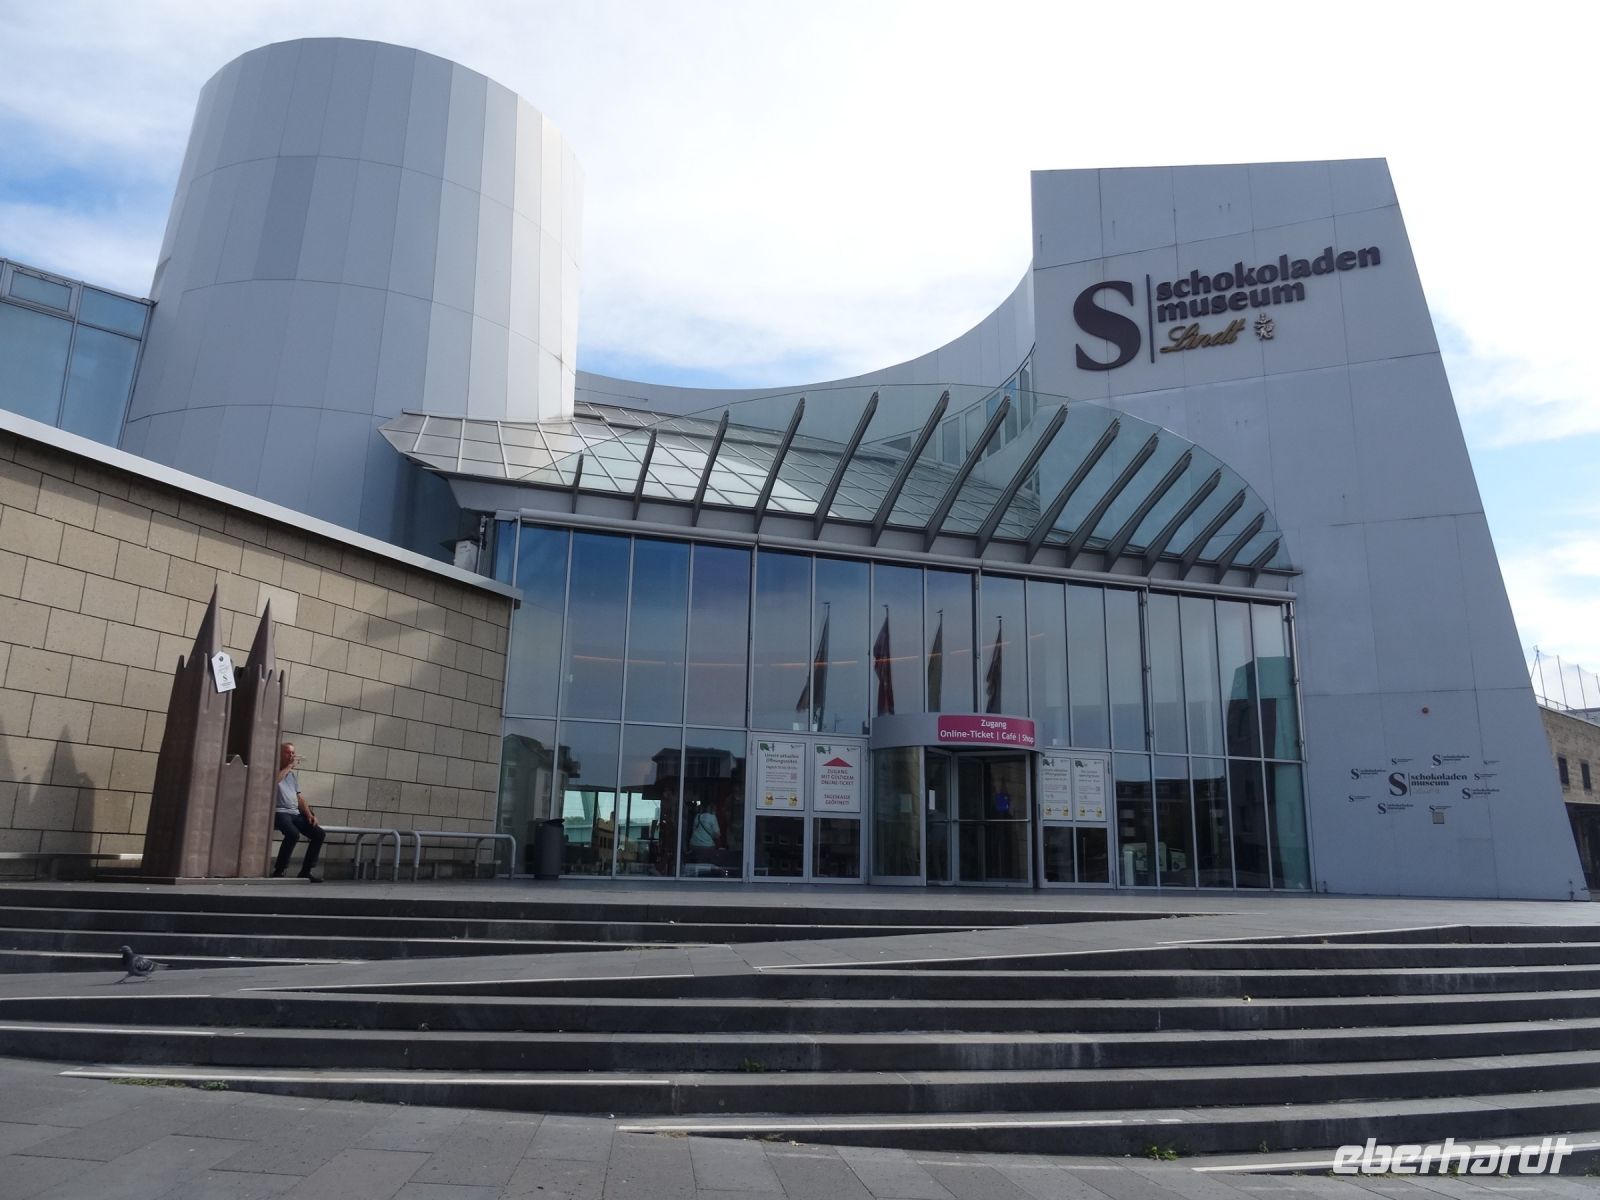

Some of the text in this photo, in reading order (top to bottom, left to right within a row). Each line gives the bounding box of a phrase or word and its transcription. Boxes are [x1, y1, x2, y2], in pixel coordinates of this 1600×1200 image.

[1156, 246, 1381, 301] schokoladen
[1156, 280, 1306, 323] museum
[1073, 280, 1141, 372] S
[1159, 318, 1246, 354] Lindt
[940, 730, 994, 739] Online-Ticket
[1001, 732, 1017, 741] Café
[1022, 734, 1034, 744] Shop
[980, 719, 1007, 730] Zugang
[1388, 772, 1408, 797] S
[1410, 773, 1468, 781] schokoladen
